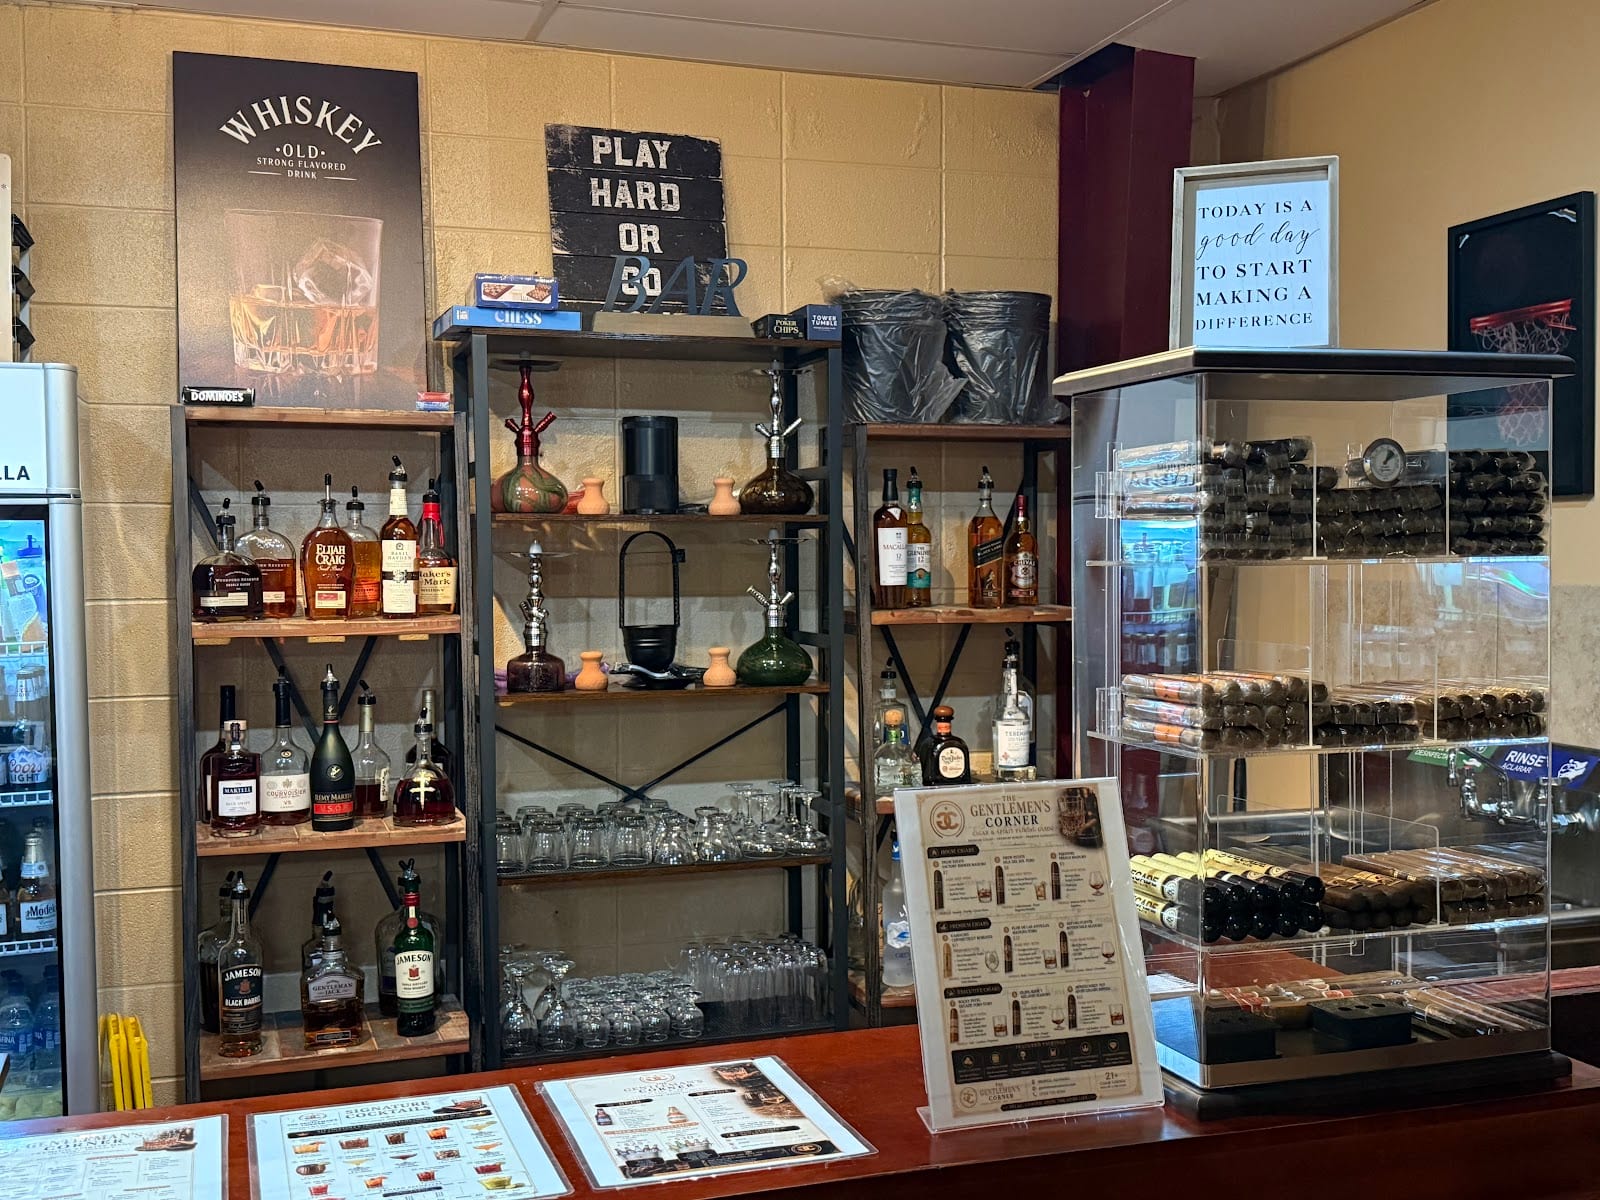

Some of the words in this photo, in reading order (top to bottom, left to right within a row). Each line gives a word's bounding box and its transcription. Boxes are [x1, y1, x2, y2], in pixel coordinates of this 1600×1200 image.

[219, 95, 382, 155] WHISKEY
[282, 143, 318, 159] OLD
[591, 135, 672, 170] PLAY
[256, 157, 294, 167] STRONG
[298, 160, 346, 171] FLAVORED
[287, 170, 317, 179] DRINK
[590, 177, 681, 213] HARD
[1199, 203, 1266, 219] TODAY
[1275, 200, 1292, 213] IS
[1300, 199, 1312, 211] A
[618, 223, 664, 254] OR
[1196, 222, 1264, 260] good
[1270, 221, 1320, 254] day
[1196, 265, 1226, 280] TO
[1236, 259, 1312, 278] START
[602, 253, 748, 317] BAR
[1196, 286, 1288, 306] MAKING
[1298, 285, 1312, 300] A
[495, 310, 542, 325] CHESS
[1196, 312, 1313, 331] DIFFERENCE
[773, 326, 799, 334] CHIPS
[190, 391, 244, 402] DOMINOES
[0, 465, 30, 481] LA
[316, 544, 345, 555] ELIJAH
[316, 554, 345, 565] CRAIG
[1415, 748, 1448, 760] DESINFECTA
[1505, 750, 1545, 767] RINSE
[9, 759, 41, 773] Coors
[1501, 762, 1532, 774] ACLARAR
[224, 786, 251, 794] MARTELL
[266, 789, 307, 797] COURVOISIER
[970, 799, 1051, 817] GENTLEMEN'S
[985, 815, 1039, 828] CORNER
[396, 953, 431, 965] JAMESON
[224, 968, 262, 981] JAMESON
[312, 982, 353, 991] GENTLEMAN
[225, 998, 243, 1006] BLACK
[1105, 1072, 1118, 1081] 21+
[989, 1093, 1014, 1101] CORNER
[345, 1100, 430, 1114] SIGNATURE
[345, 1106, 431, 1119] COCKTAILS
